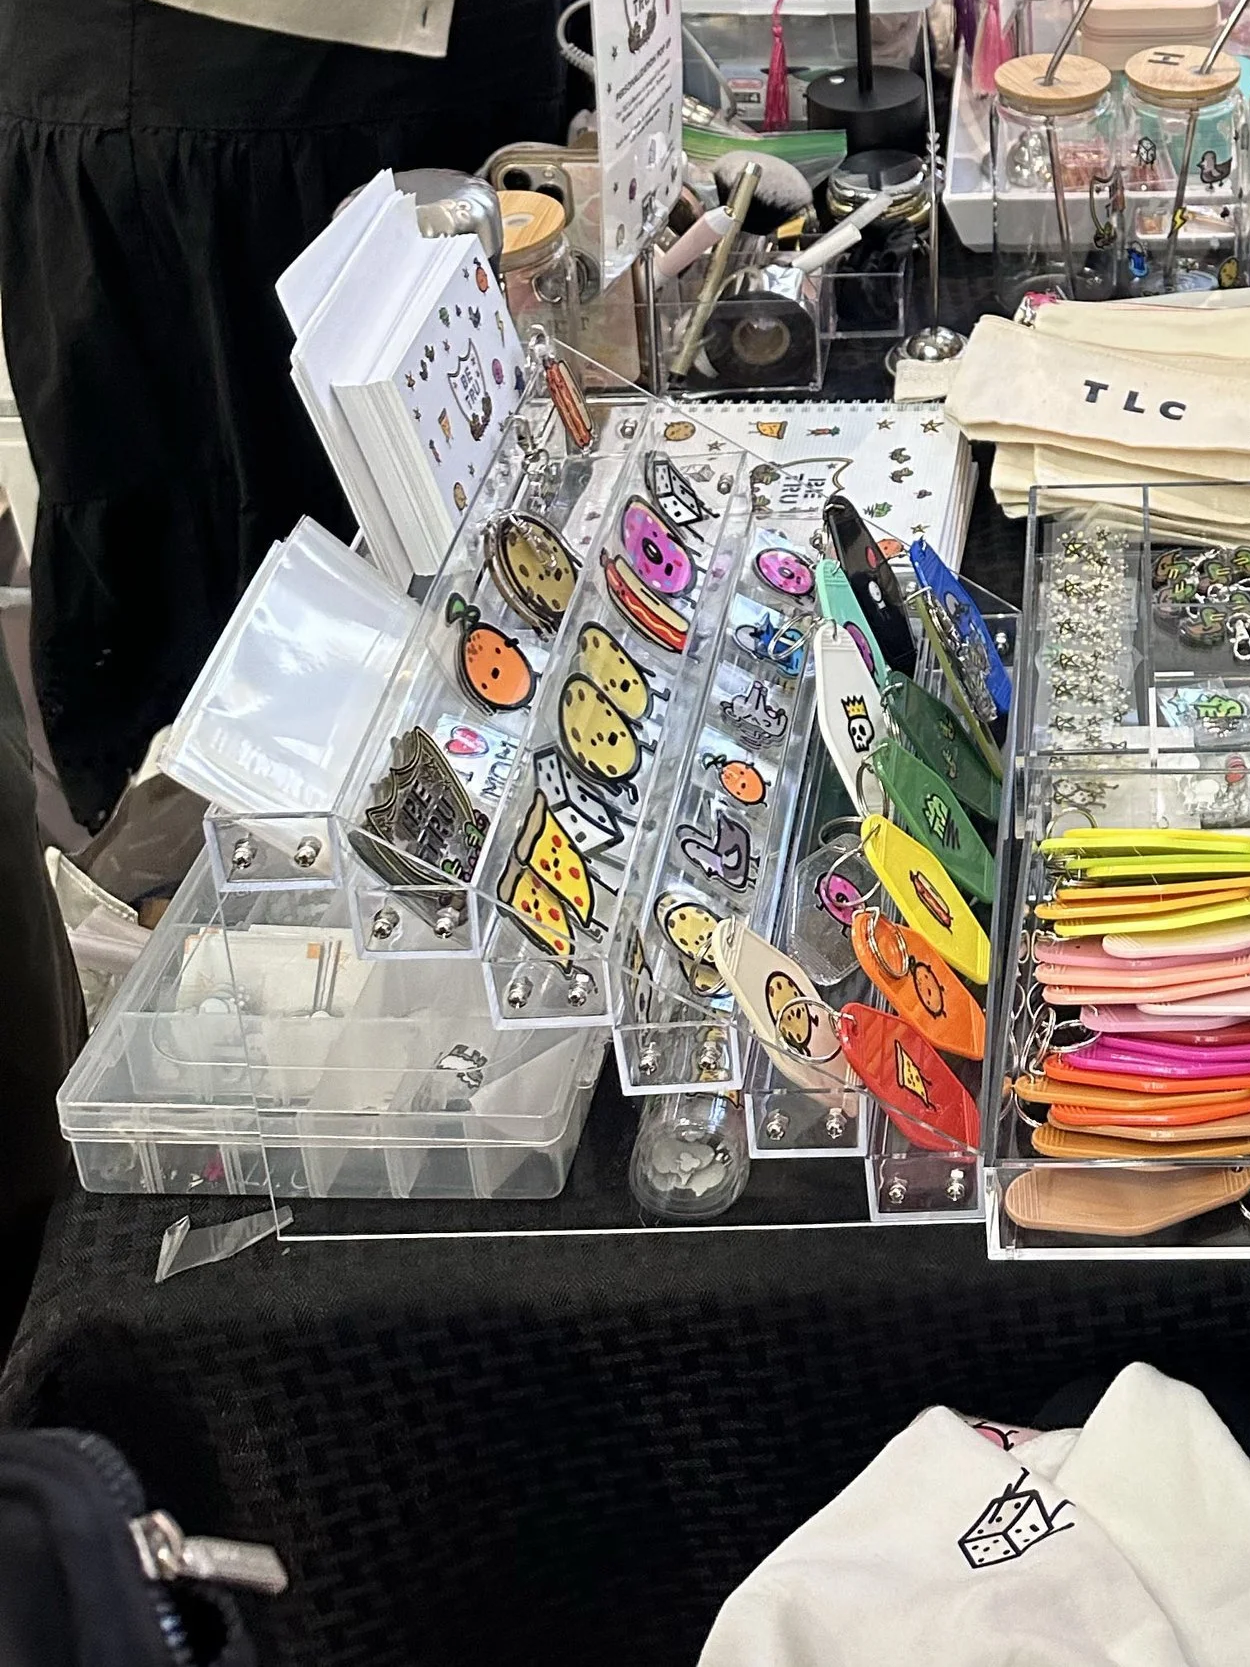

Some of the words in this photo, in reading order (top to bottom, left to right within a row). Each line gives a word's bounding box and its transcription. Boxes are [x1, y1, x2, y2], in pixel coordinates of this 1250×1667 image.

[460, 366, 473, 391] BE
[465, 379, 480, 410] TRU
[1083, 379, 1187, 421] TLC
[779, 473, 805, 504] TRU
[803, 478, 827, 499] BE
[480, 739, 520, 799] MOM
